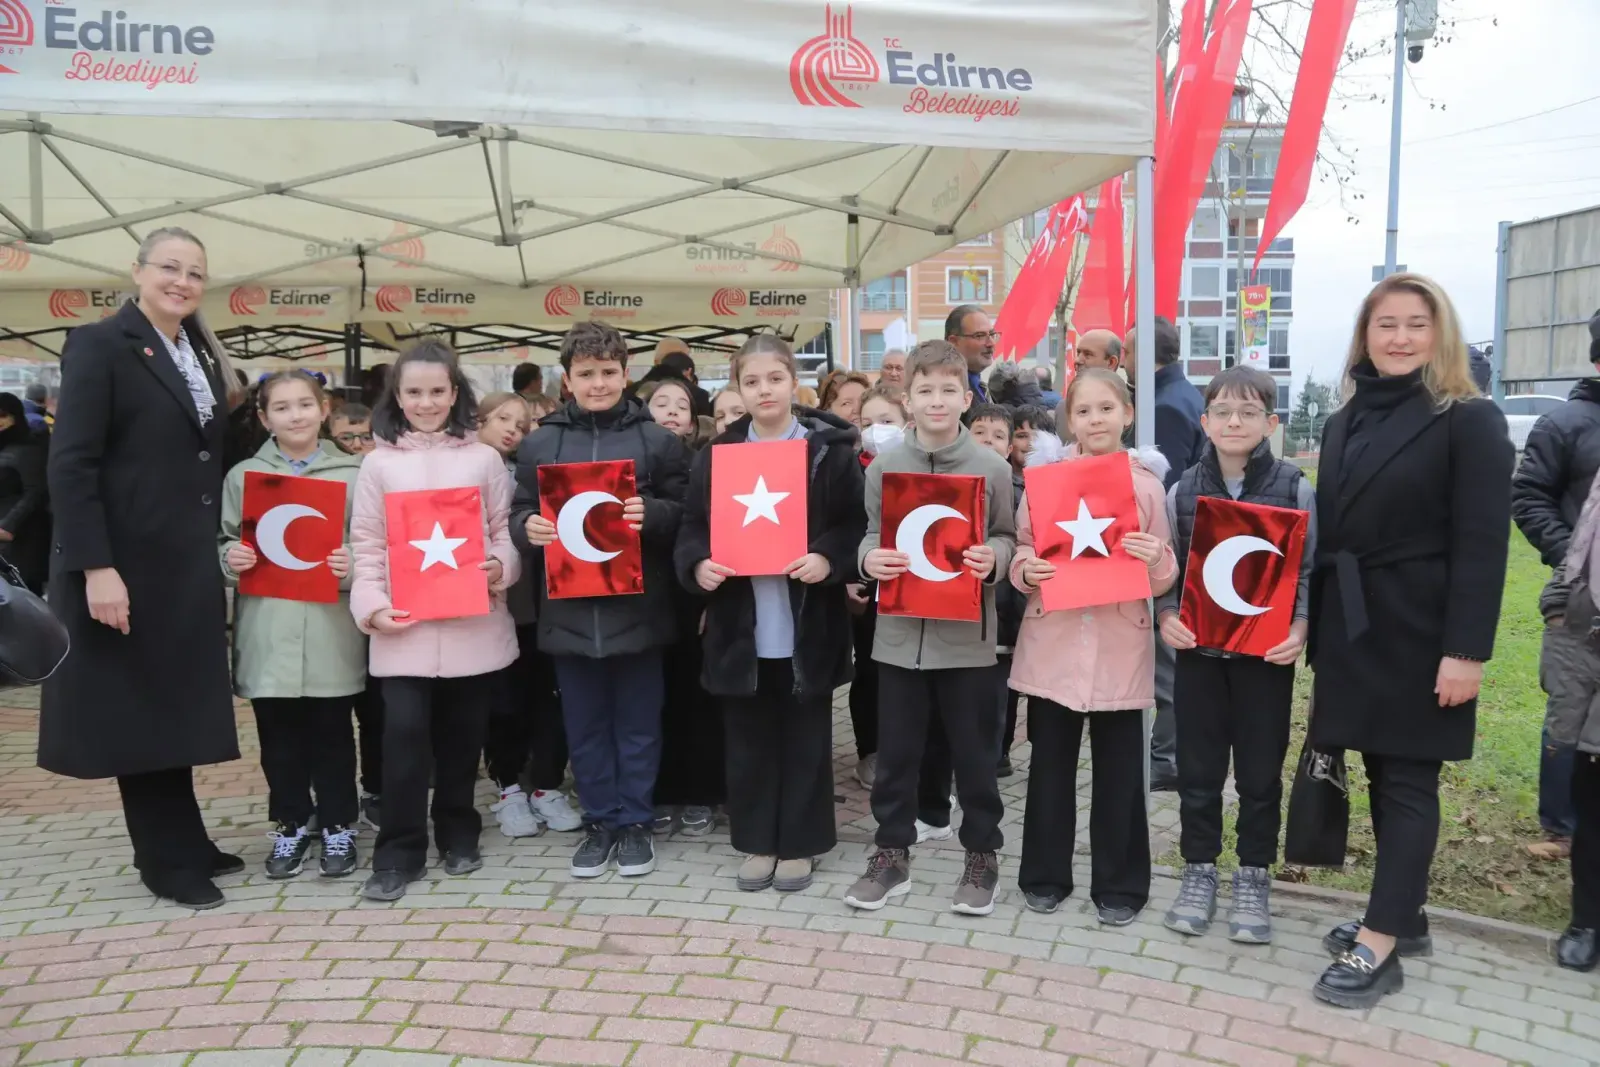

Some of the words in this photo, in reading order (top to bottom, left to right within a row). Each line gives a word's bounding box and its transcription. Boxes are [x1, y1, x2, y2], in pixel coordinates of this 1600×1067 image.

[45, 6, 215, 56] Edirne
[883, 37, 902, 49] T.C.
[65, 51, 200, 90] Belediyesi
[886, 50, 1034, 91] Edirne
[841, 83, 871, 91] 1867
[902, 87, 1021, 122] Belediyesi
[269, 290, 331, 305] Edirne
[415, 288, 476, 304] Edirne
[583, 291, 644, 307] Edirne
[749, 290, 808, 306] Edirne
